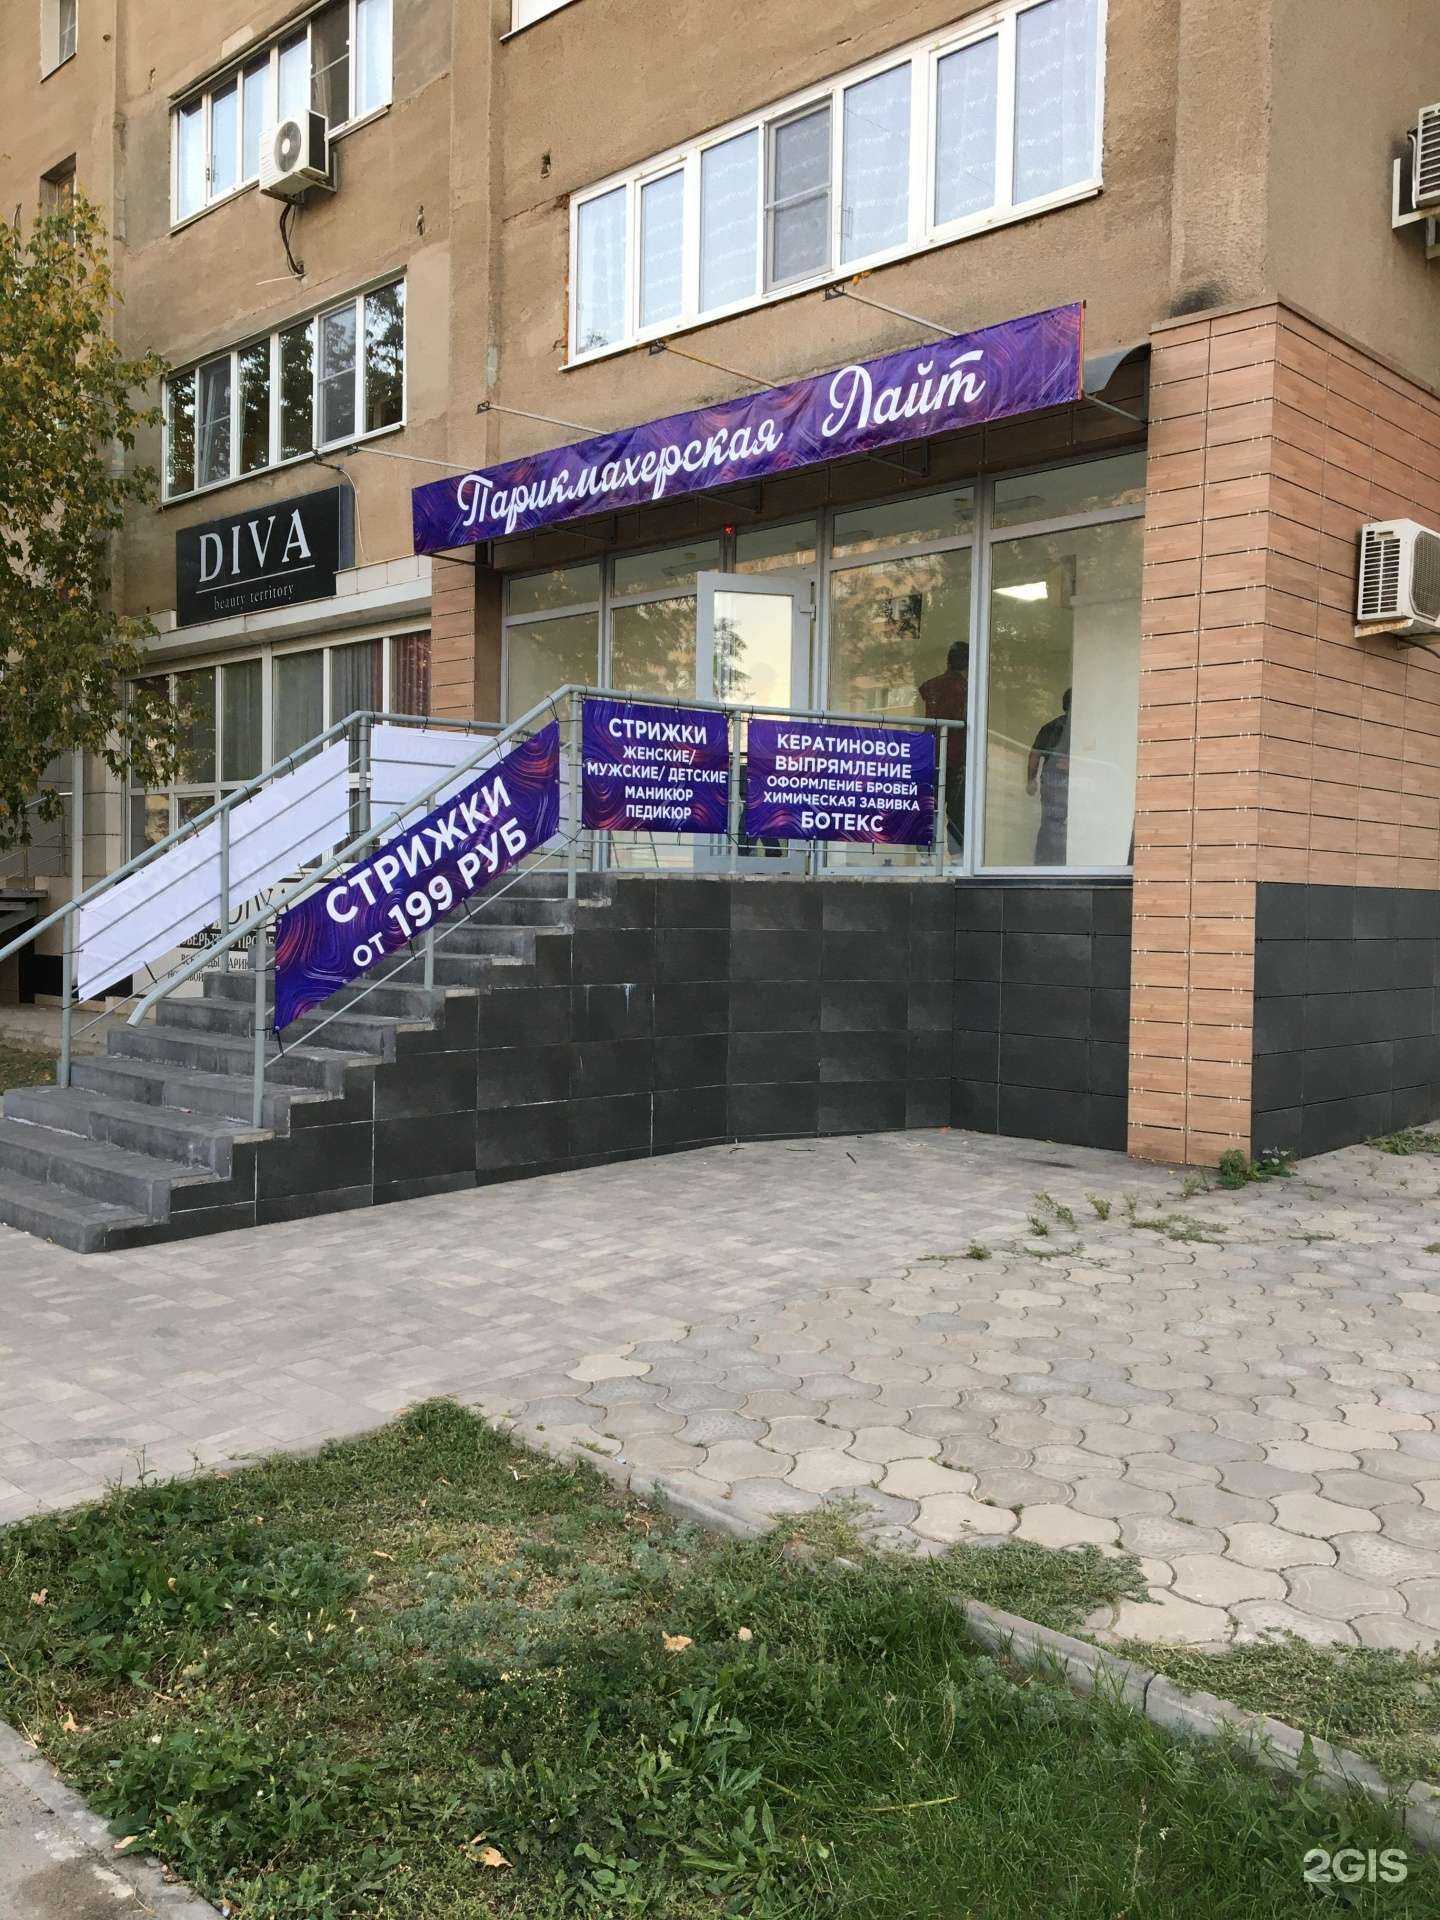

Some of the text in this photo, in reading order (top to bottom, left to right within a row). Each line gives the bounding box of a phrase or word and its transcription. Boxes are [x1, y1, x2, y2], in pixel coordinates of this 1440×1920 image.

[457, 350, 985, 533] Парикмахерская Лайт
[199, 508, 312, 582] DIVA
[214, 583, 295, 611] beauty territory
[608, 718, 707, 745] СТРИЖКИ
[623, 745, 696, 765] ЖЕНСКИЕ/
[777, 733, 911, 758] КЕРАТИНОВОЕ
[587, 762, 728, 784] МУЖСКИЕ/ ДЕТСКИЕ
[775, 756, 912, 779] ВЫПРЯМЛЕНИЕ
[625, 786, 693, 802] МАНИКЮР
[767, 776, 918, 796] ОФОРМЛЕНИЕ БРОВЕЙ
[626, 805, 692, 820] ПЕДИКЮР
[763, 791, 920, 811] ХИМИЧЕСКАЯ ЗАВИВКА
[801, 811, 884, 832] БОТЕКС
[326, 776, 511, 923] СТРИЖКИ
[388, 875, 453, 937] 199
[457, 817, 527, 890] РУБ
